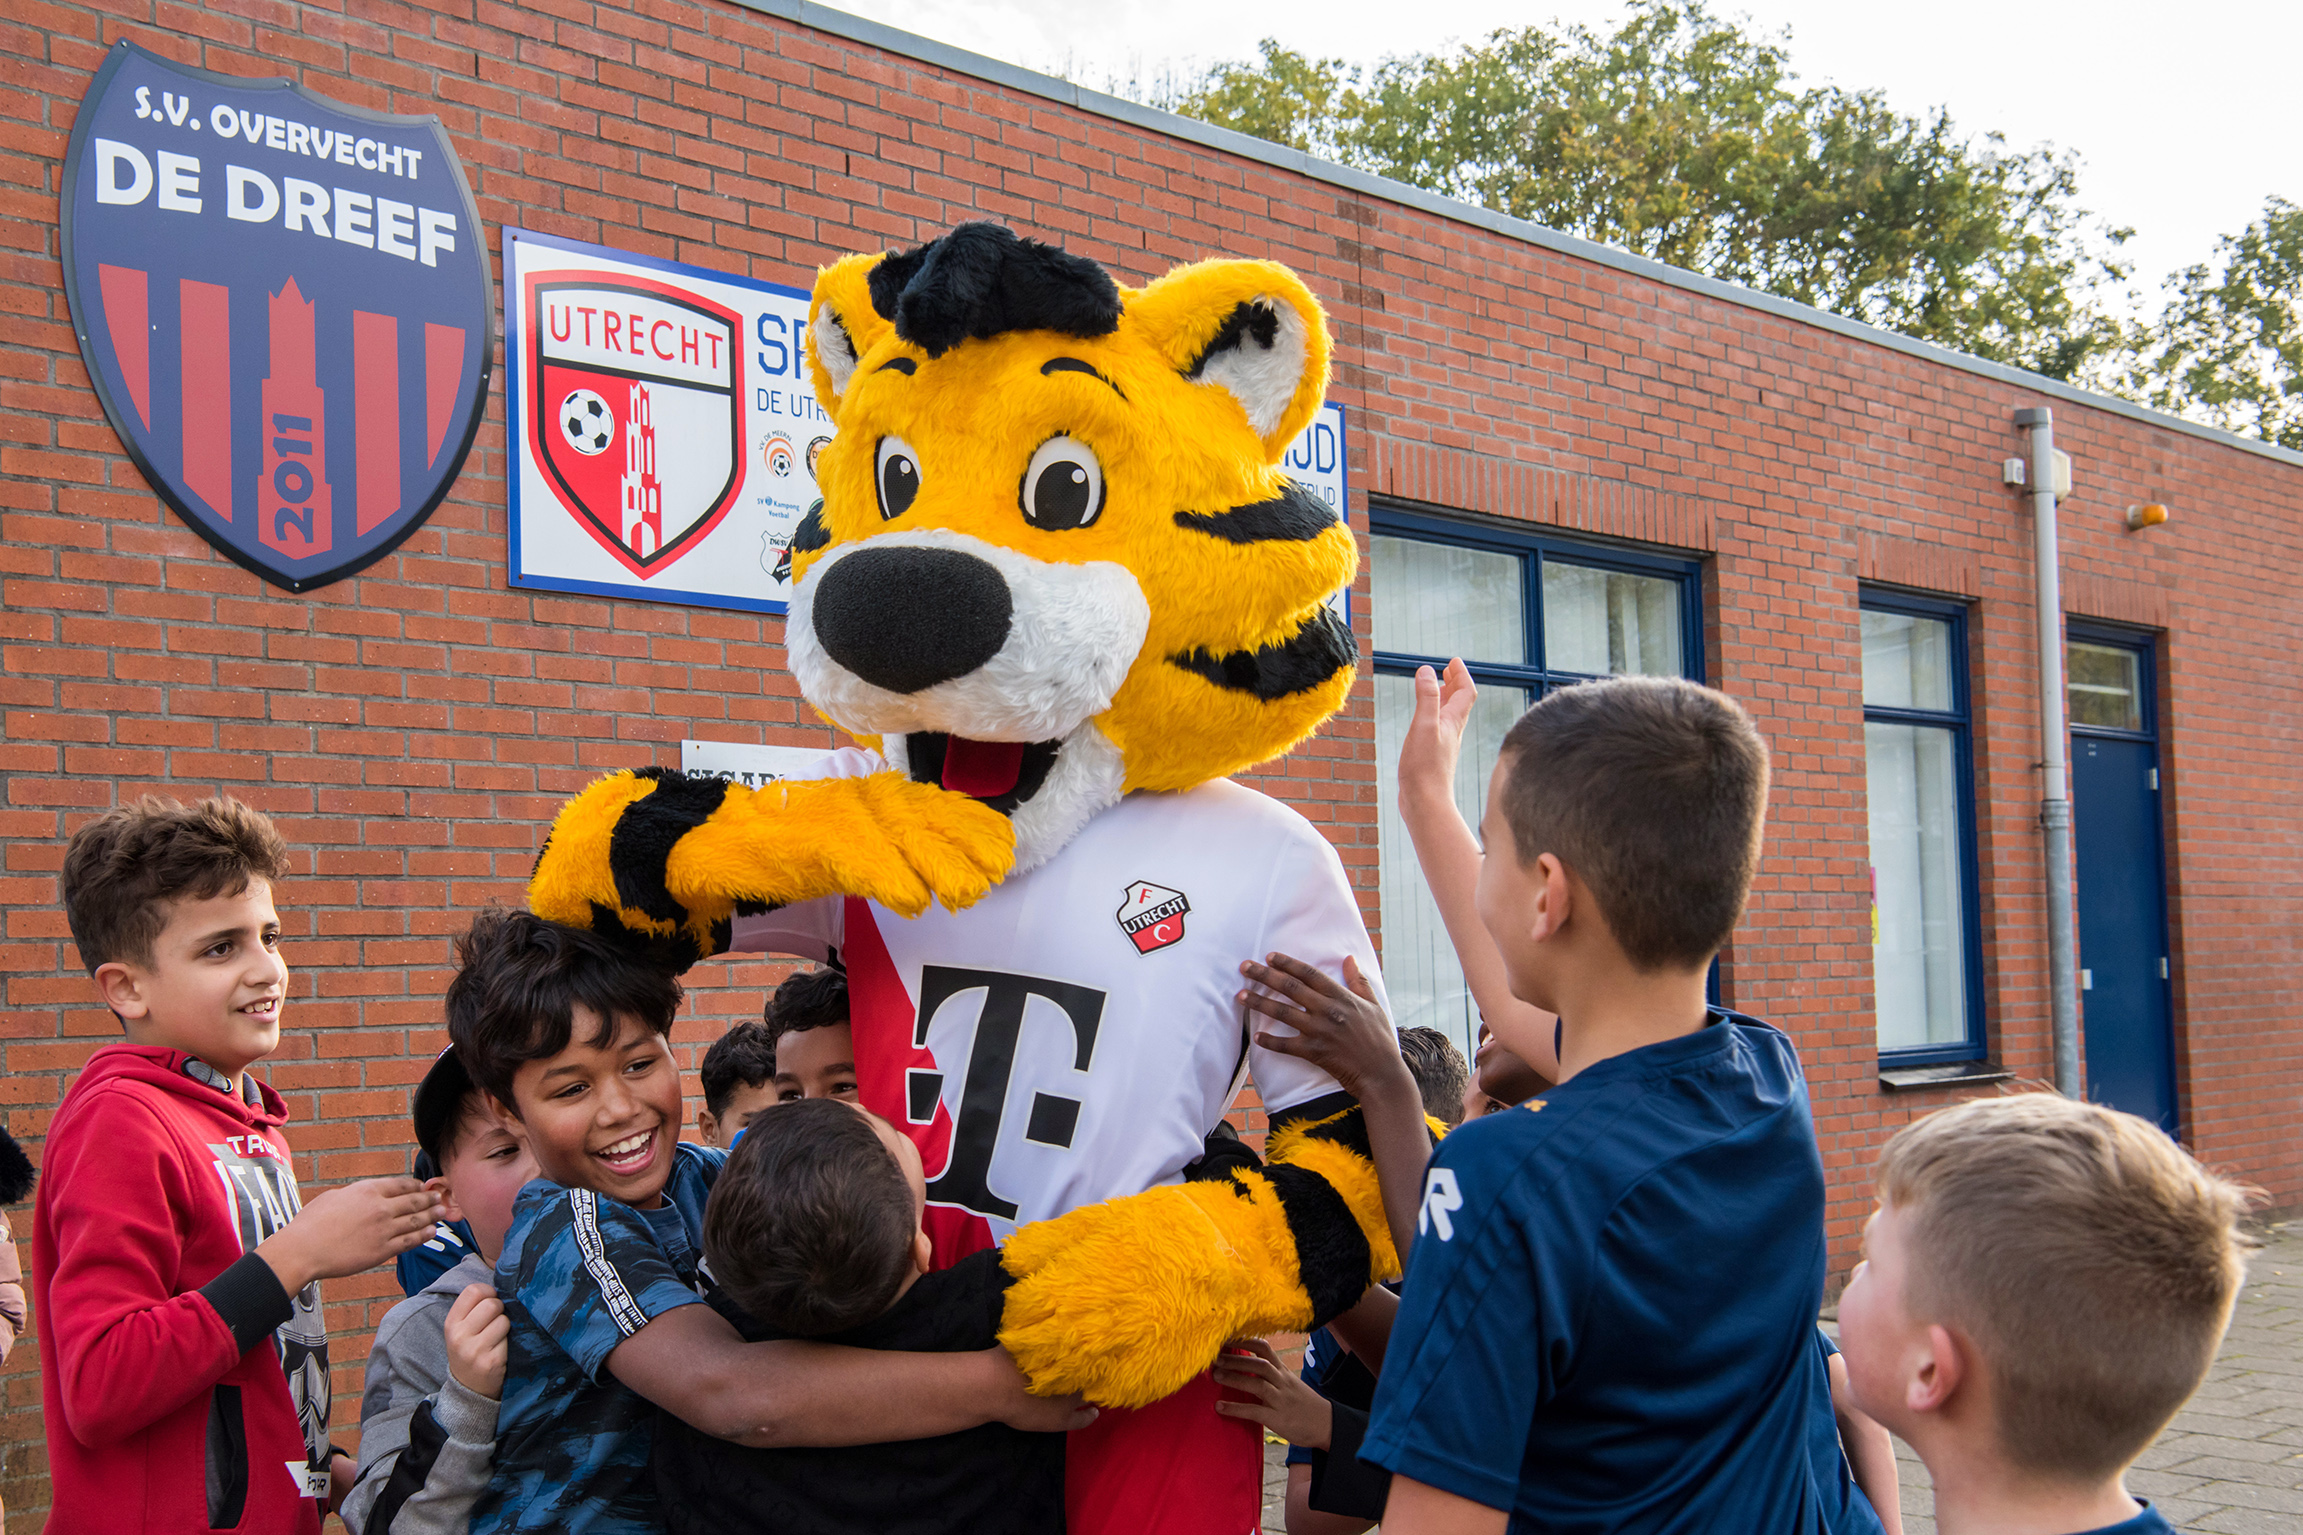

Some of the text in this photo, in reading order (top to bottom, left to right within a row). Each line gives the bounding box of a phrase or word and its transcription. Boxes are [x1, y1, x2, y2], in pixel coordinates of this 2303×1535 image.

[134, 85, 422, 180] S.V. OVERVECHT
[95, 137, 458, 268] DE DREEF
[549, 304, 724, 370] UTRECHT
[757, 387, 834, 424] DE UTR
[771, 429, 793, 443] MEERN
[272, 412, 315, 544] 2011
[768, 509, 790, 519] Voetbal
[773, 500, 800, 512] Kampong
[1138, 887, 1153, 905] F
[1122, 896, 1186, 934] UTRECHT
[1153, 923, 1171, 943] C
